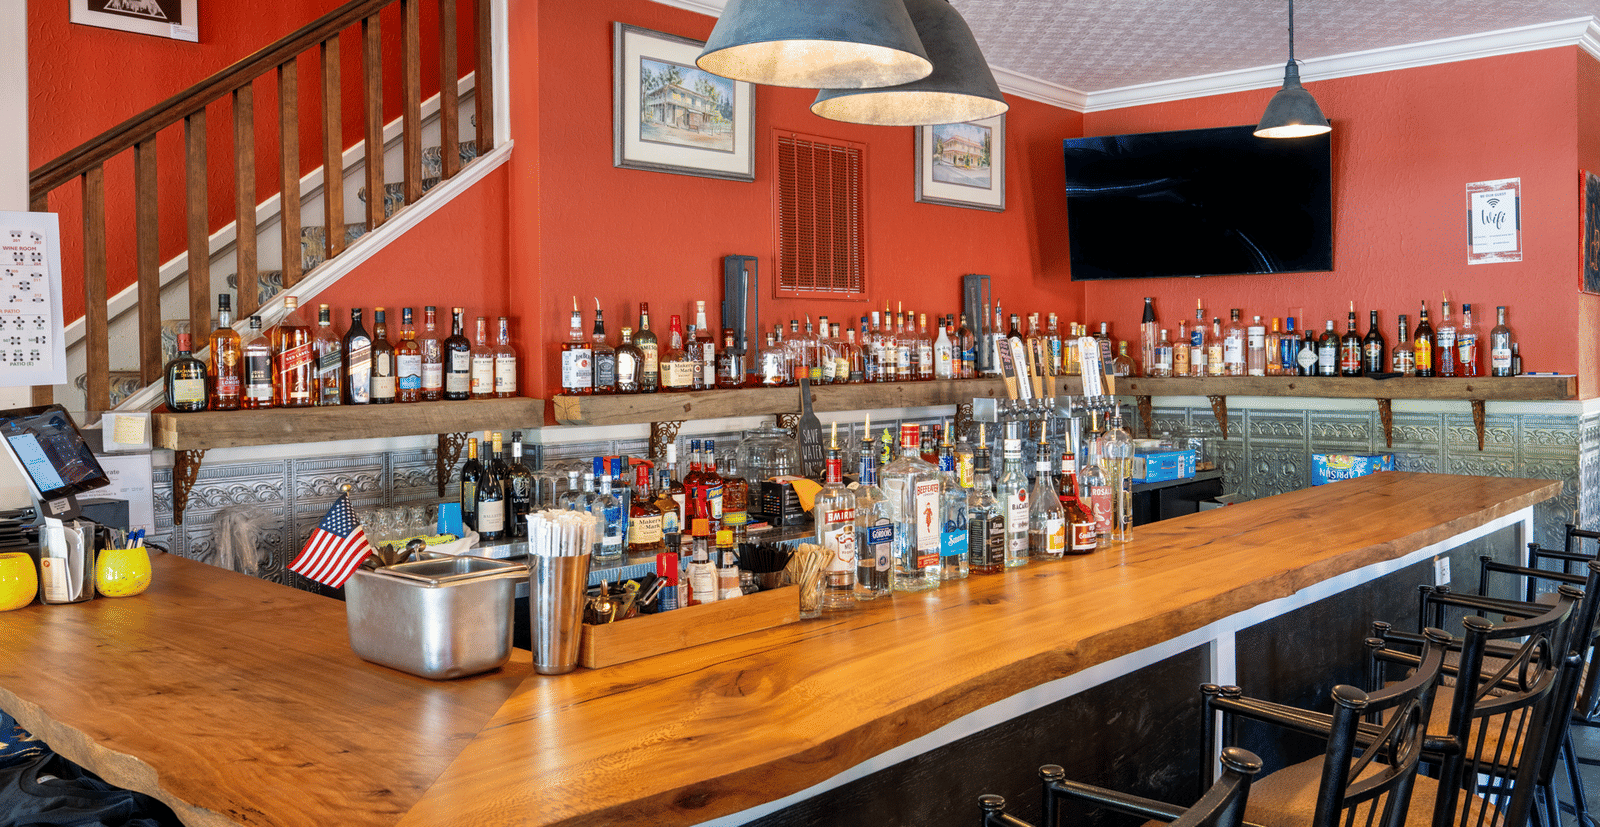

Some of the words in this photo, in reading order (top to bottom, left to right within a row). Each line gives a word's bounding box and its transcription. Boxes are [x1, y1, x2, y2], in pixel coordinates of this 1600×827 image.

[1481, 209, 1506, 230] Wifi
[296, 350, 310, 358] LABEL
[802, 428, 818, 444] SAVE
[801, 444, 823, 460] WATER
[917, 483, 939, 496] BEEFEATER
[828, 510, 855, 521] SMIRN
